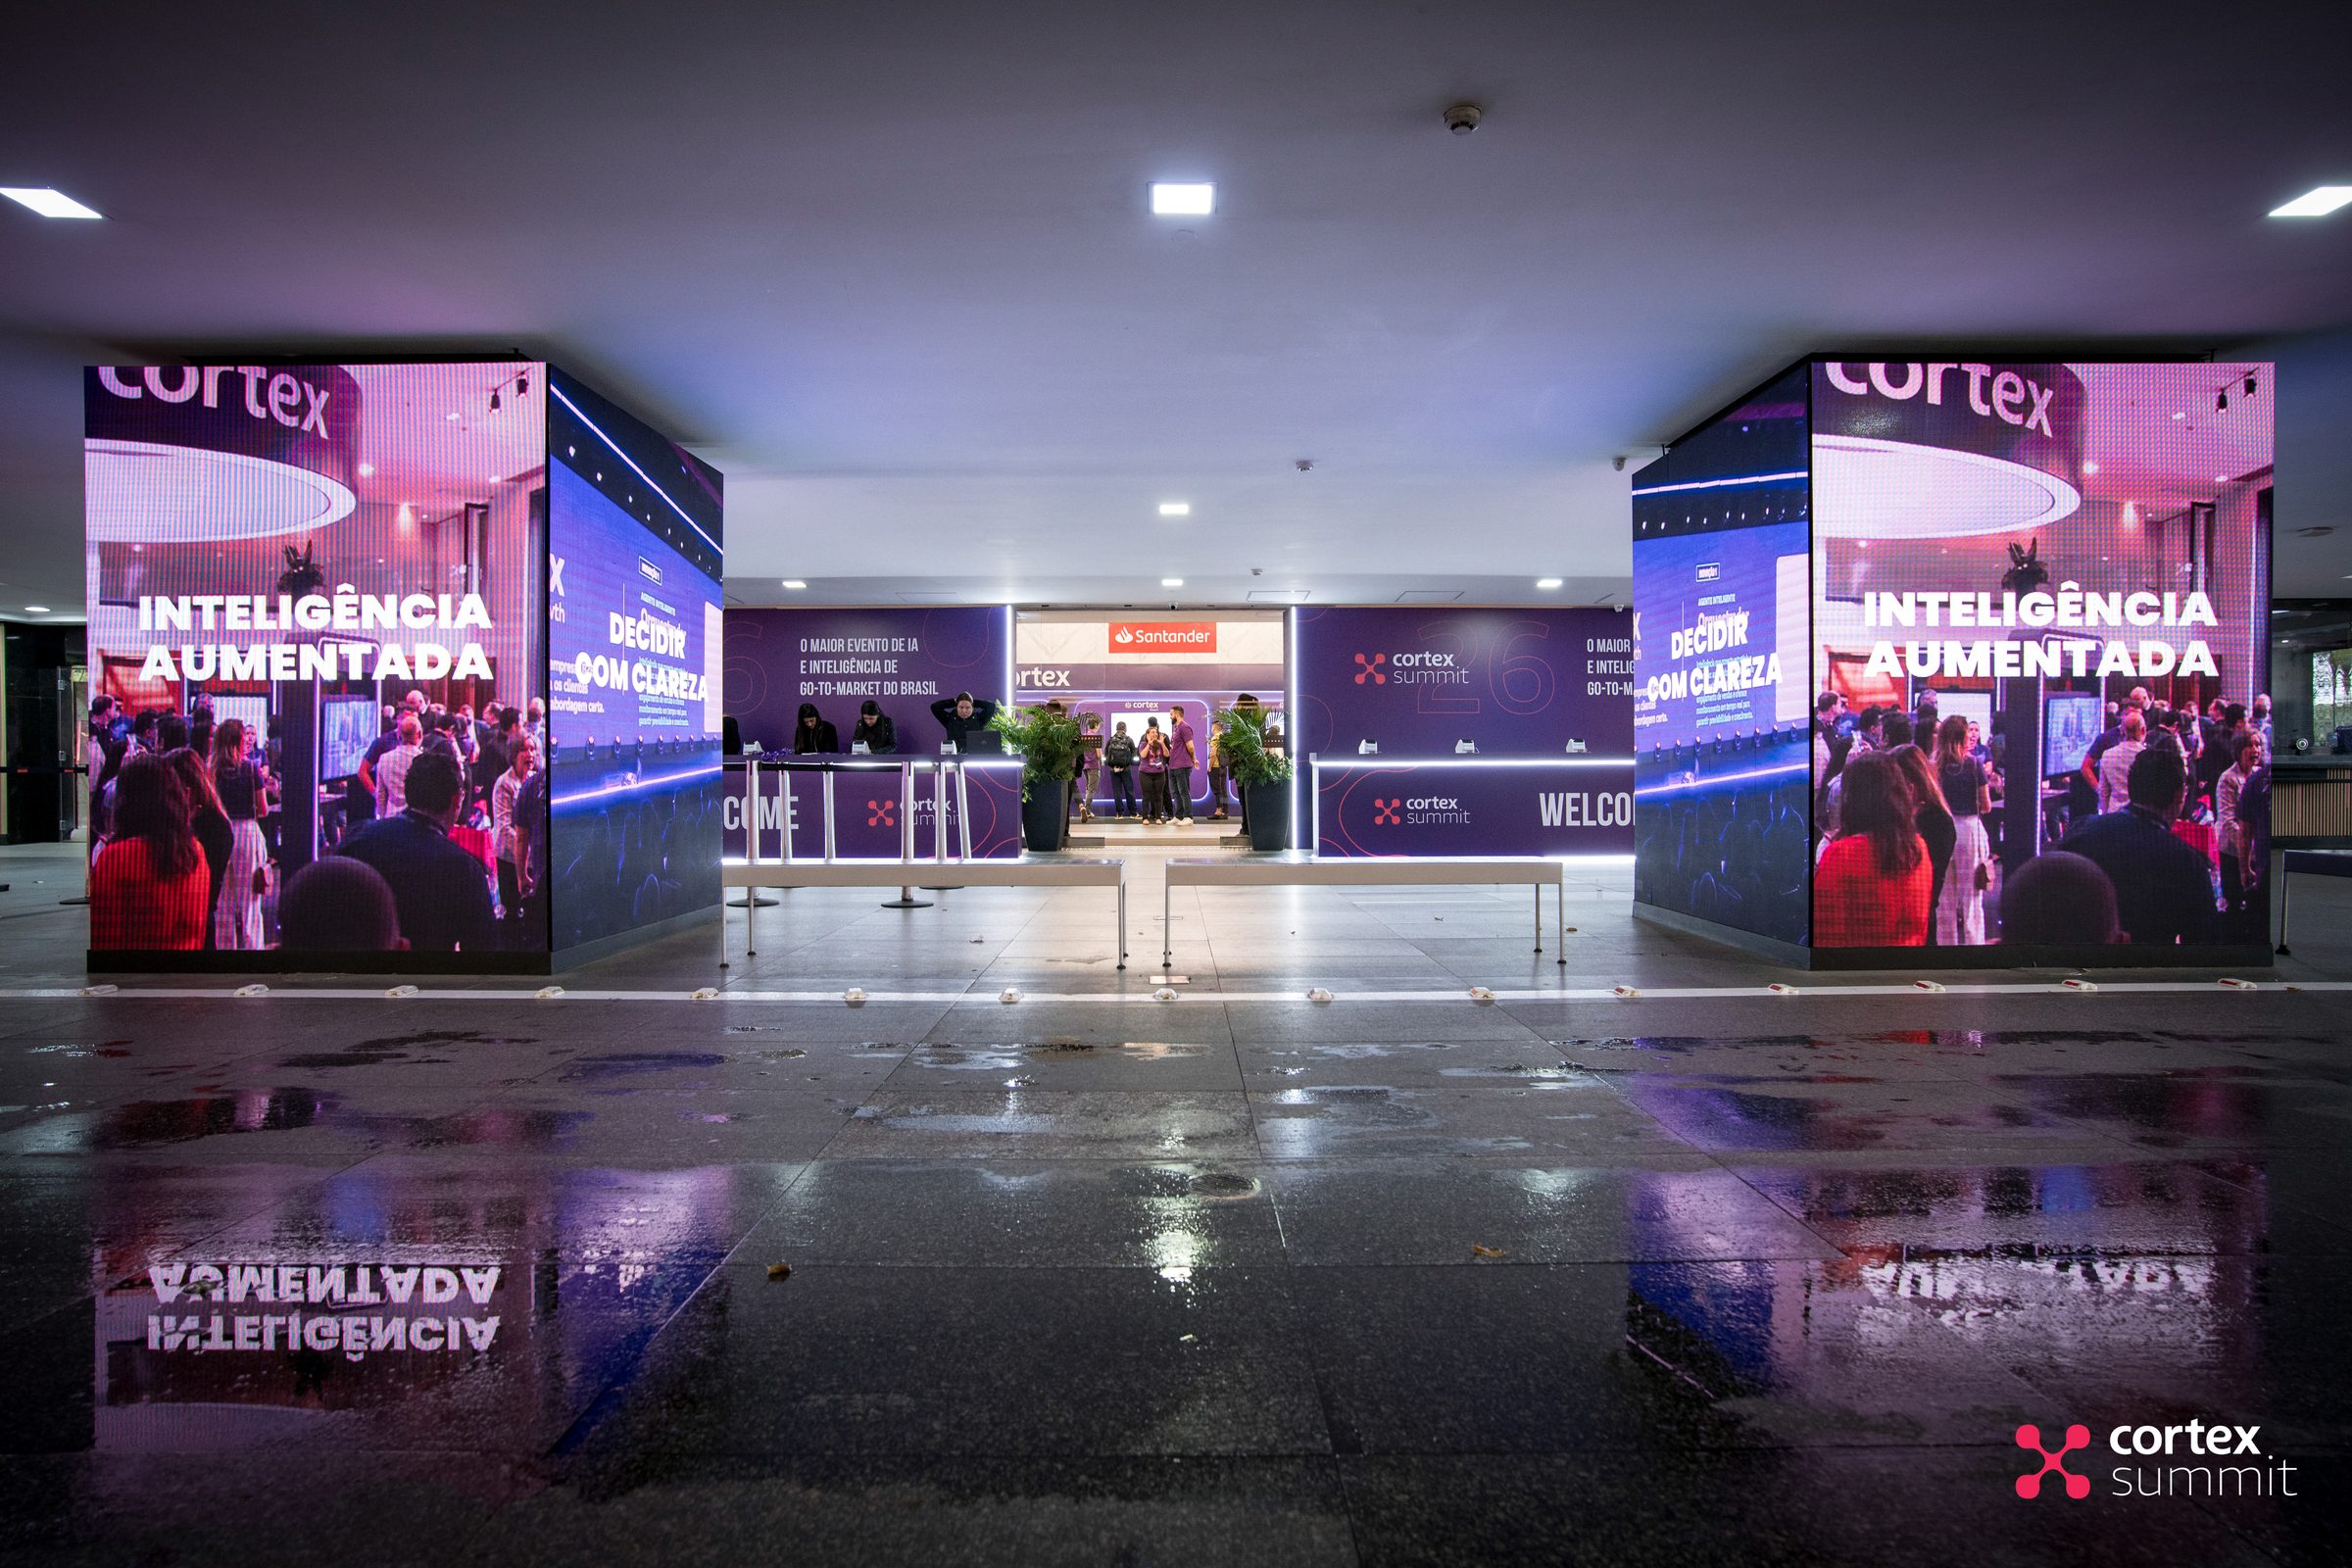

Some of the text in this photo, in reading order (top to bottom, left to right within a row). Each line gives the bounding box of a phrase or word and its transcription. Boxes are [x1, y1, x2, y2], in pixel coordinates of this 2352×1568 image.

[139, 582, 492, 630] INTELIGÊNCIA
[1864, 580, 2219, 627] INTELIGÊNCIA
[610, 612, 686, 659] DECIDIR
[1136, 629, 1210, 644] Santander
[1671, 614, 1748, 660] DECIDIR
[800, 638, 918, 653] O MAIOR EVENTO DE IA
[1587, 638, 1631, 653] O MAIOR
[138, 643, 494, 681] AUMENTADA
[800, 657, 898, 674] E INTELIGÊNCIA DE
[1393, 651, 1454, 667] cortex
[1587, 660, 1593, 674] E
[1864, 640, 2219, 678] AUMENTADA
[575, 652, 628, 691] COM
[632, 662, 709, 702] CLAREZA
[1394, 666, 1469, 684] summit
[1647, 670, 1687, 702] COM
[1690, 653, 1783, 696] CLAREZA
[800, 681, 939, 696] GO-TO-MARKET DO BRASIL
[1406, 797, 1457, 809] cortex
[1407, 808, 1471, 824] summit
